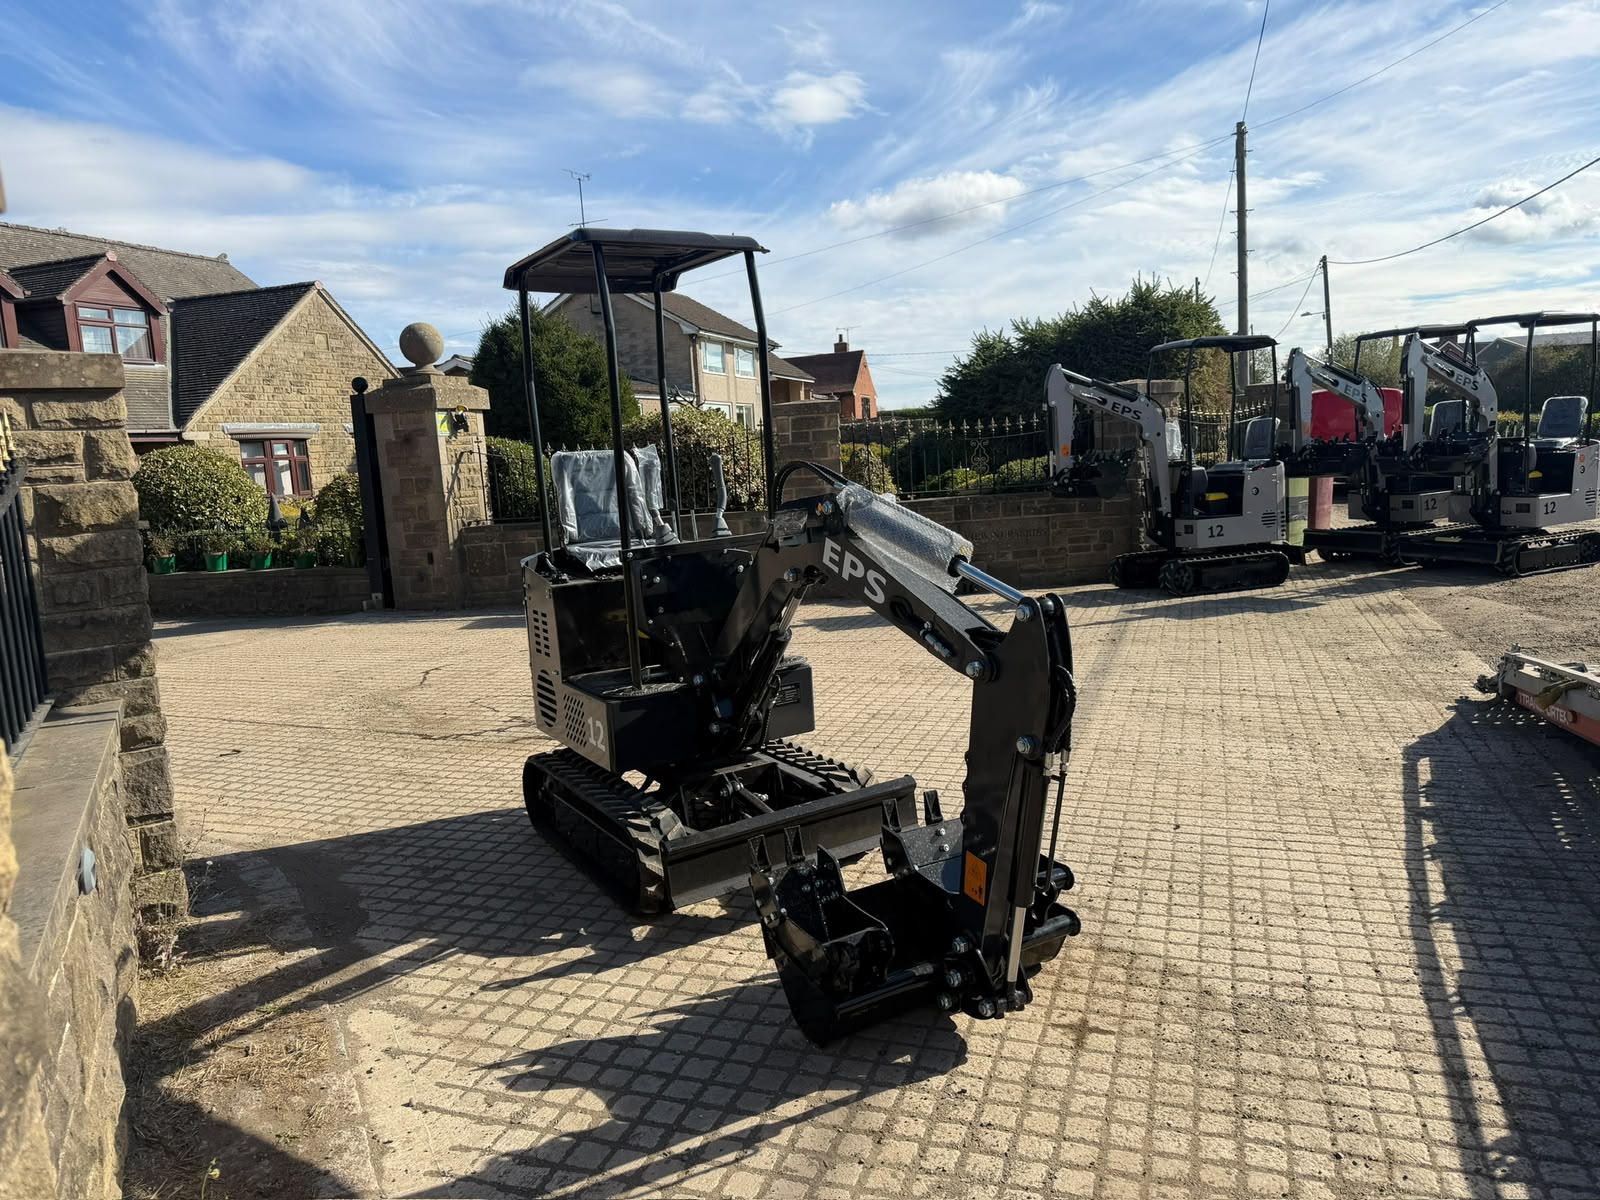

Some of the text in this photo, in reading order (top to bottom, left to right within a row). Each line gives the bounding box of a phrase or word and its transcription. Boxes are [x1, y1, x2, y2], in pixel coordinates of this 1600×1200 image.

[1455, 374, 1480, 391] EPS
[1343, 384, 1368, 403] EPS
[1111, 401, 1142, 420] EPS
[1423, 498, 1438, 510] 12
[1543, 502, 1557, 514] 12
[1207, 524, 1225, 538] 12
[823, 537, 887, 604] EPS
[587, 716, 606, 752] 12
